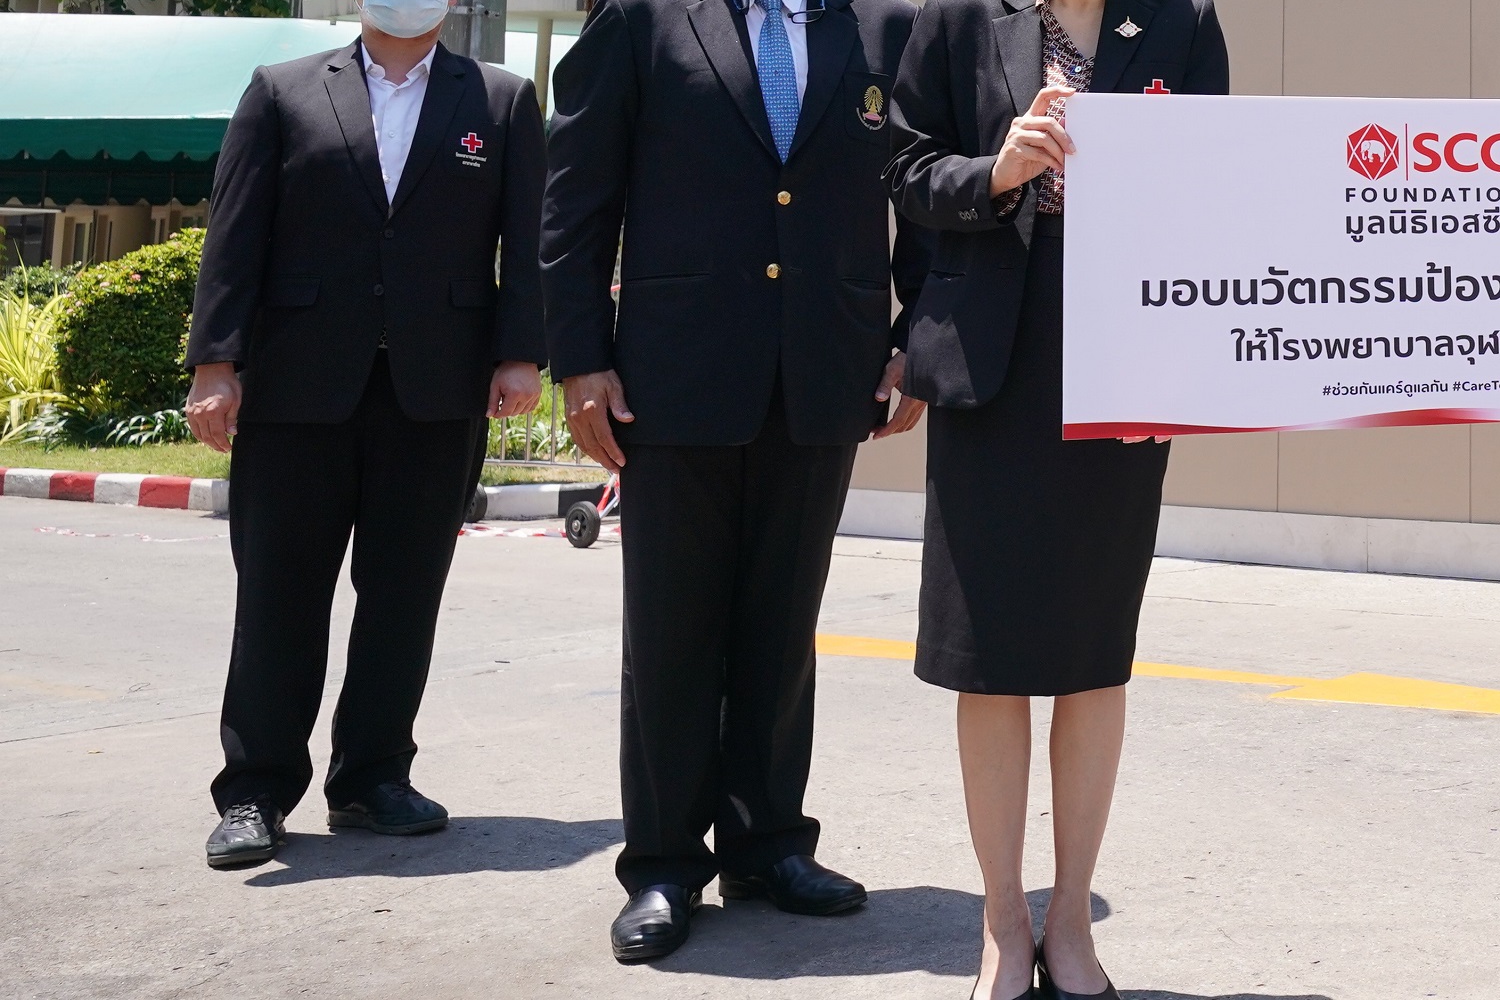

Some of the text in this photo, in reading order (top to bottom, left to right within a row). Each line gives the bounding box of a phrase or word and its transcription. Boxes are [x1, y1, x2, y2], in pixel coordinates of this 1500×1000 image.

[1322, 380, 1449, 398] #ช่วยกันแคร์ดูแลกัน
